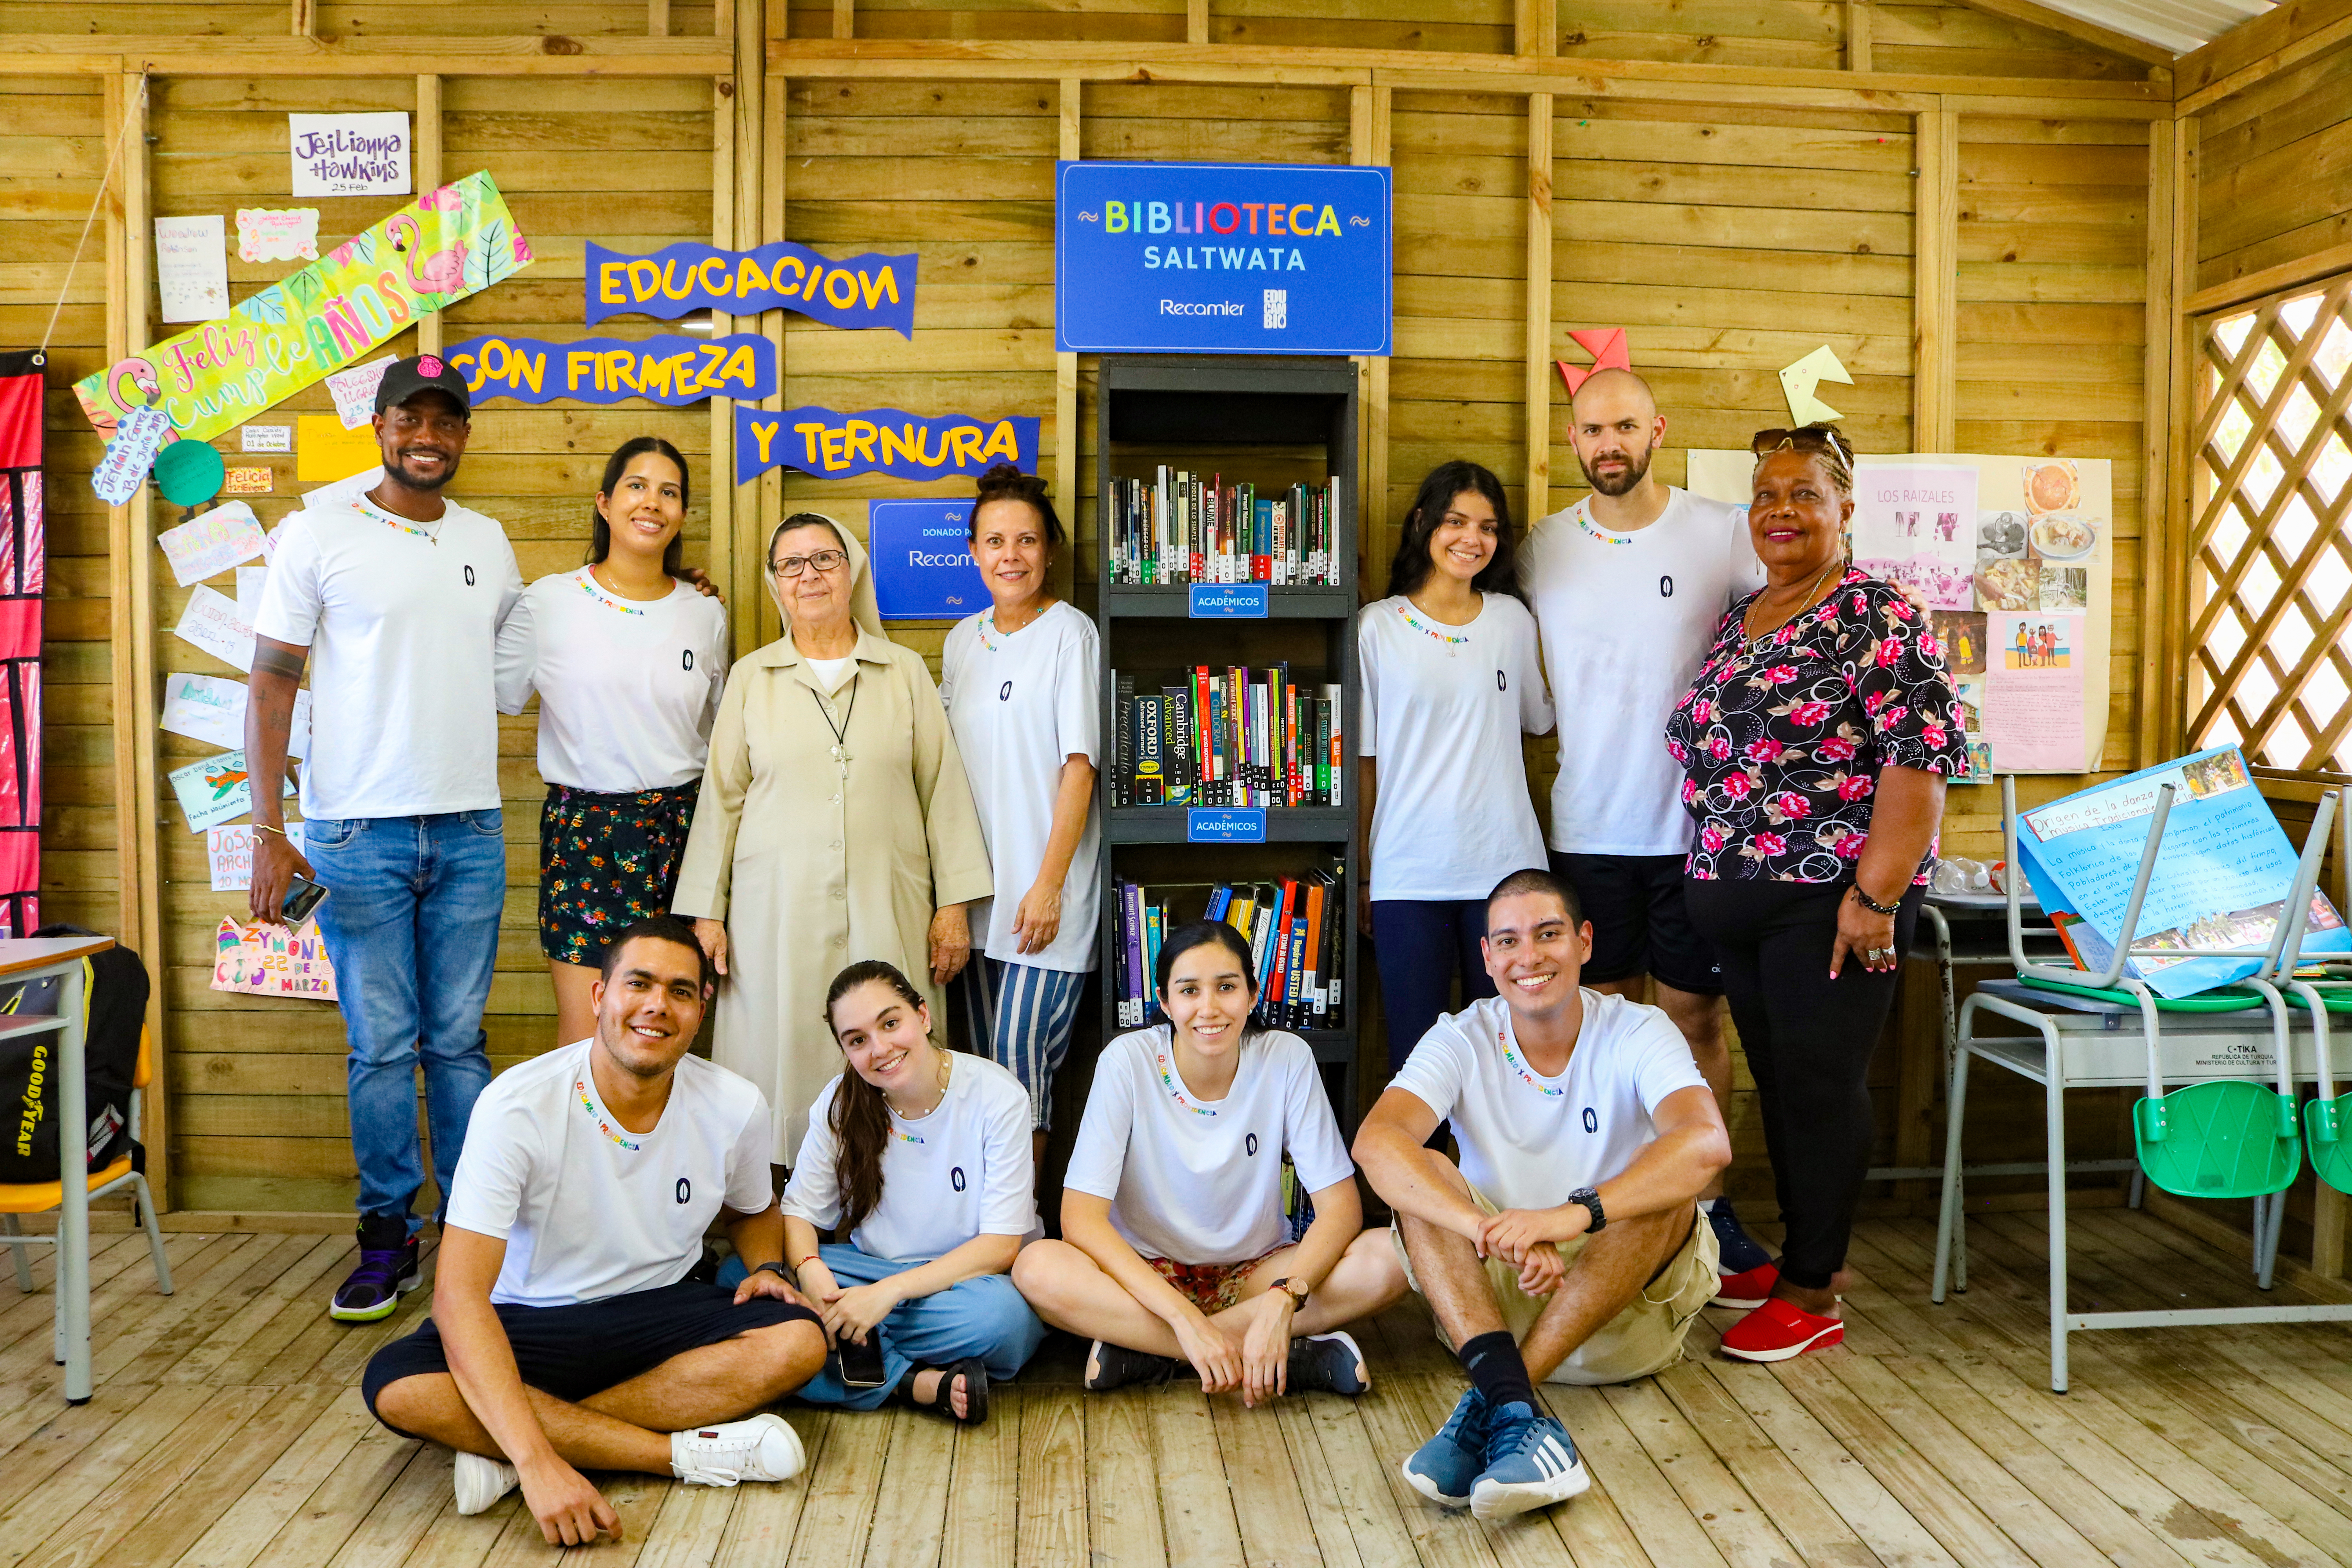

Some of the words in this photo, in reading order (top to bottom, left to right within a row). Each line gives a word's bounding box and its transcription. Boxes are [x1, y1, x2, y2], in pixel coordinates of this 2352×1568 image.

[310, 156, 399, 182] Hawkins
[349, 183, 368, 192] Feb
[1105, 201, 1342, 236] BIBLIOTECA
[1144, 246, 1306, 271] SALTWATA
[599, 256, 900, 310] EDUCACION
[1160, 299, 1245, 316] Recamier
[162, 326, 258, 393] Feliz
[450, 339, 546, 394] CON
[567, 344, 756, 397] FIRMEZA
[128, 464, 141, 477] de
[137, 436, 152, 461] Junio
[750, 422, 779, 463] Y
[794, 419, 1019, 472] TERNURA
[1878, 490, 1899, 503] LOS
[1903, 490, 1954, 504] RAIZALES
[923, 528, 962, 536] DONADO
[1198, 595, 1259, 606] ACADÉMICOS
[1146, 700, 1158, 755] OXFORD
[1164, 695, 1176, 745] Advanced
[1174, 693, 1189, 760] Cambridge
[1212, 699, 1221, 748] CHILDCRAFT
[1120, 700, 1131, 774] Precálculo
[192, 761, 211, 774] David
[188, 809, 208, 822] Fecha
[2032, 812, 2079, 833] Origen
[2085, 806, 2101, 817] de
[2105, 800, 2117, 811] la
[2122, 790, 2154, 807] danza
[1196, 820, 1257, 831] ACADÉMICOS
[2047, 857, 2063, 867] La
[2203, 818, 2211, 826] el
[2215, 802, 2252, 822] patrimonio
[2098, 824, 2123, 832] Isla
[2225, 817, 2259, 835] primeros
[2123, 863, 2131, 871] de
[2216, 839, 2239, 849] datos
[2242, 825, 2274, 840] históricos
[218, 875, 231, 888] 10
[2223, 870, 2249, 880] proceso
[2266, 859, 2282, 869] usos
[2105, 881, 2120, 890] año
[1127, 892, 1136, 915] Harcourt
[2084, 898, 2108, 910] Estas
[1257, 911, 1269, 933] Miley
[1280, 933, 1289, 950] INGLÉS
[1292, 939, 1303, 968] Repárelo
[263, 955, 288, 971] 22
[295, 963, 310, 975] DE
[1277, 956, 1285, 974] CURSO
[281, 978, 329, 993] MARZO
[1289, 969, 1301, 998] USTED
[1499, 1032, 1519, 1069] EDUCAMBIO
[1158, 1054, 1174, 1091] EDUCAMBIO
[1177, 1096, 1217, 1116] PROVIDENCIA
[17, 1045, 48, 1157] GOODYEAR
[577, 1082, 598, 1118] EDUCAMBIO
